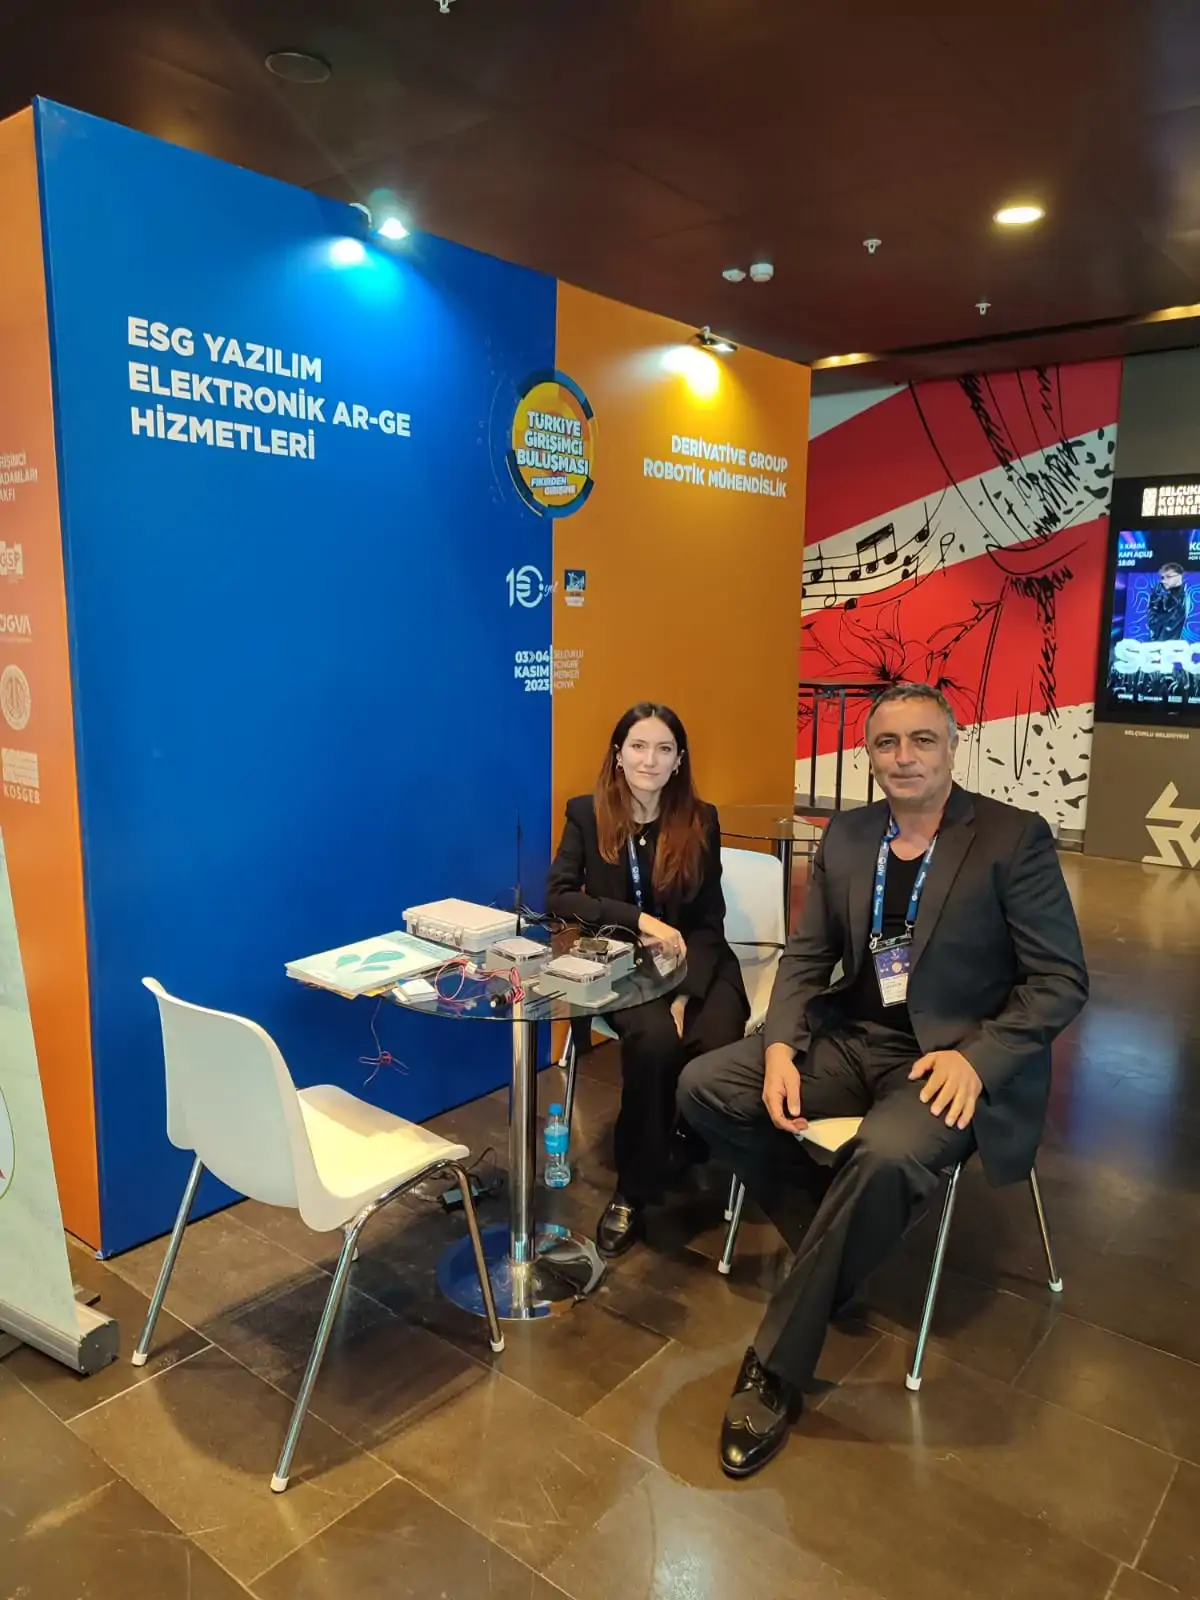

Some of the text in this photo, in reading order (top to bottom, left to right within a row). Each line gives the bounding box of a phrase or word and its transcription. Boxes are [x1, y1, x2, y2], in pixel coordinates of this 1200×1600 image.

[128, 316, 322, 383] ESG YAZILIM
[129, 361, 411, 437] ELEKTRONİK AR-GE
[131, 404, 315, 459] HİZMETLERİ
[527, 410, 582, 437] TÜRKİYE
[525, 430, 583, 456] GİRİŞİMCİ
[671, 434, 788, 472] DERİVATİVE GROUP
[517, 448, 589, 475] BULUŞMASI
[643, 457, 787, 498] ROBOTİK MÜHENDİSLİK
[514, 665, 550, 679] KASIM
[524, 679, 550, 692] 2023
